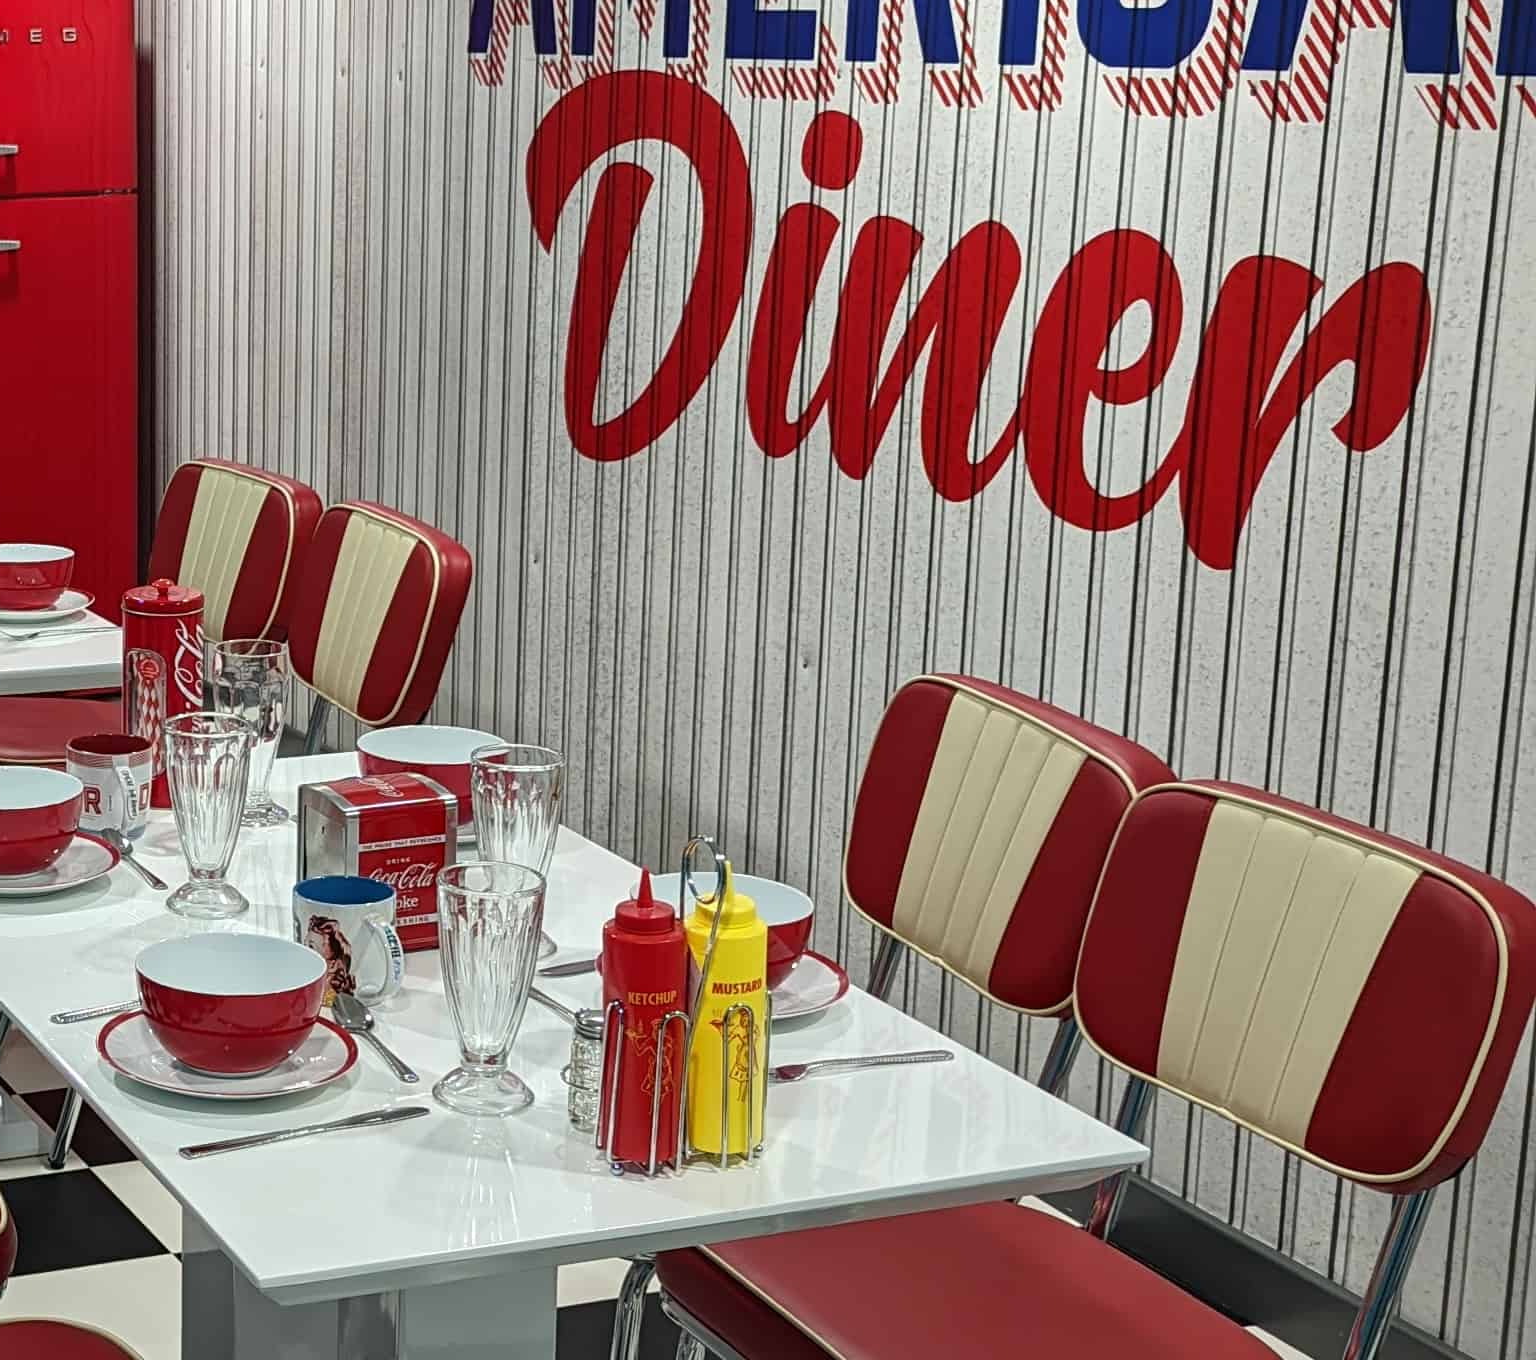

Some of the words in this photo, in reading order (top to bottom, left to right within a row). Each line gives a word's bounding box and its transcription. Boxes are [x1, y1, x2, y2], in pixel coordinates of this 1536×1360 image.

[525, 70, 1432, 571] Diner
[386, 856, 411, 865] DRINK
[397, 895, 419, 909] oke
[712, 978, 762, 995] MUSTARD
[628, 990, 677, 1006] KETCHUP
